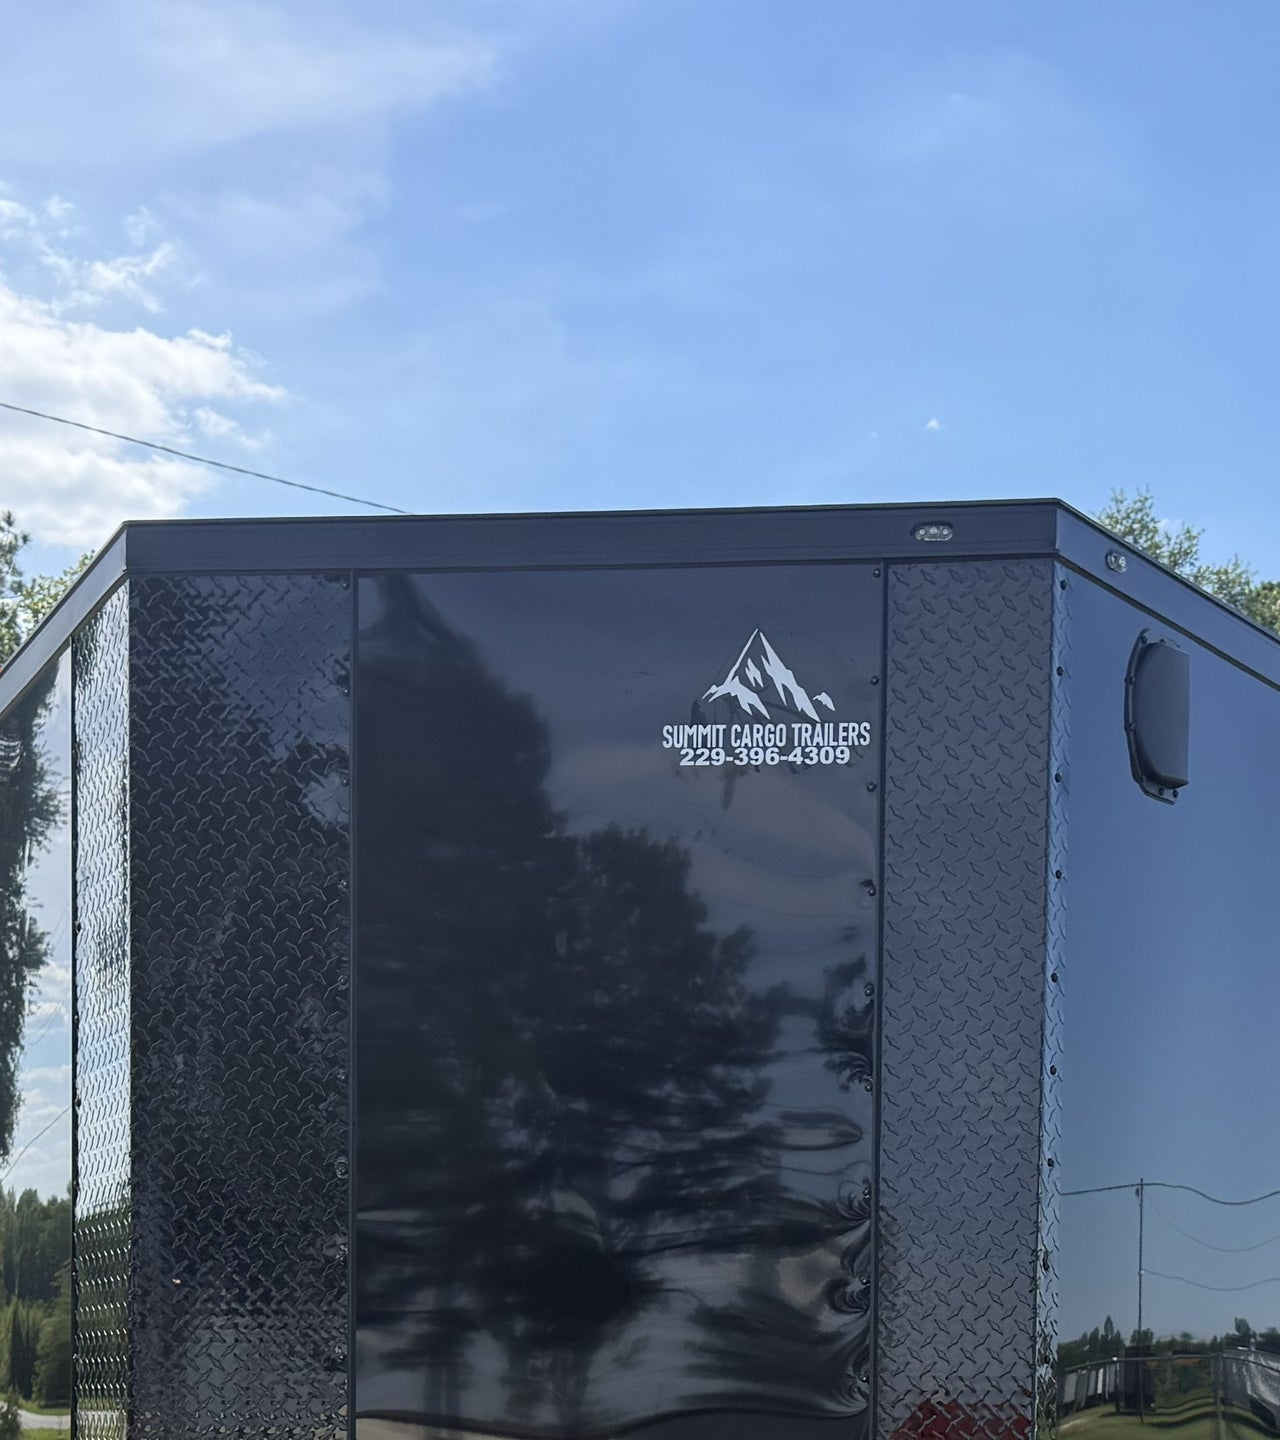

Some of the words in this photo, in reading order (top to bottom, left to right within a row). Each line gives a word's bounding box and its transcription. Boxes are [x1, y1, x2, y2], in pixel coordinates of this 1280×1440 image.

[662, 724, 726, 748] SUMMIT
[730, 723, 787, 748] CARGO
[791, 722, 870, 747] TRAILERS
[679, 746, 851, 766] 229-396-4309
